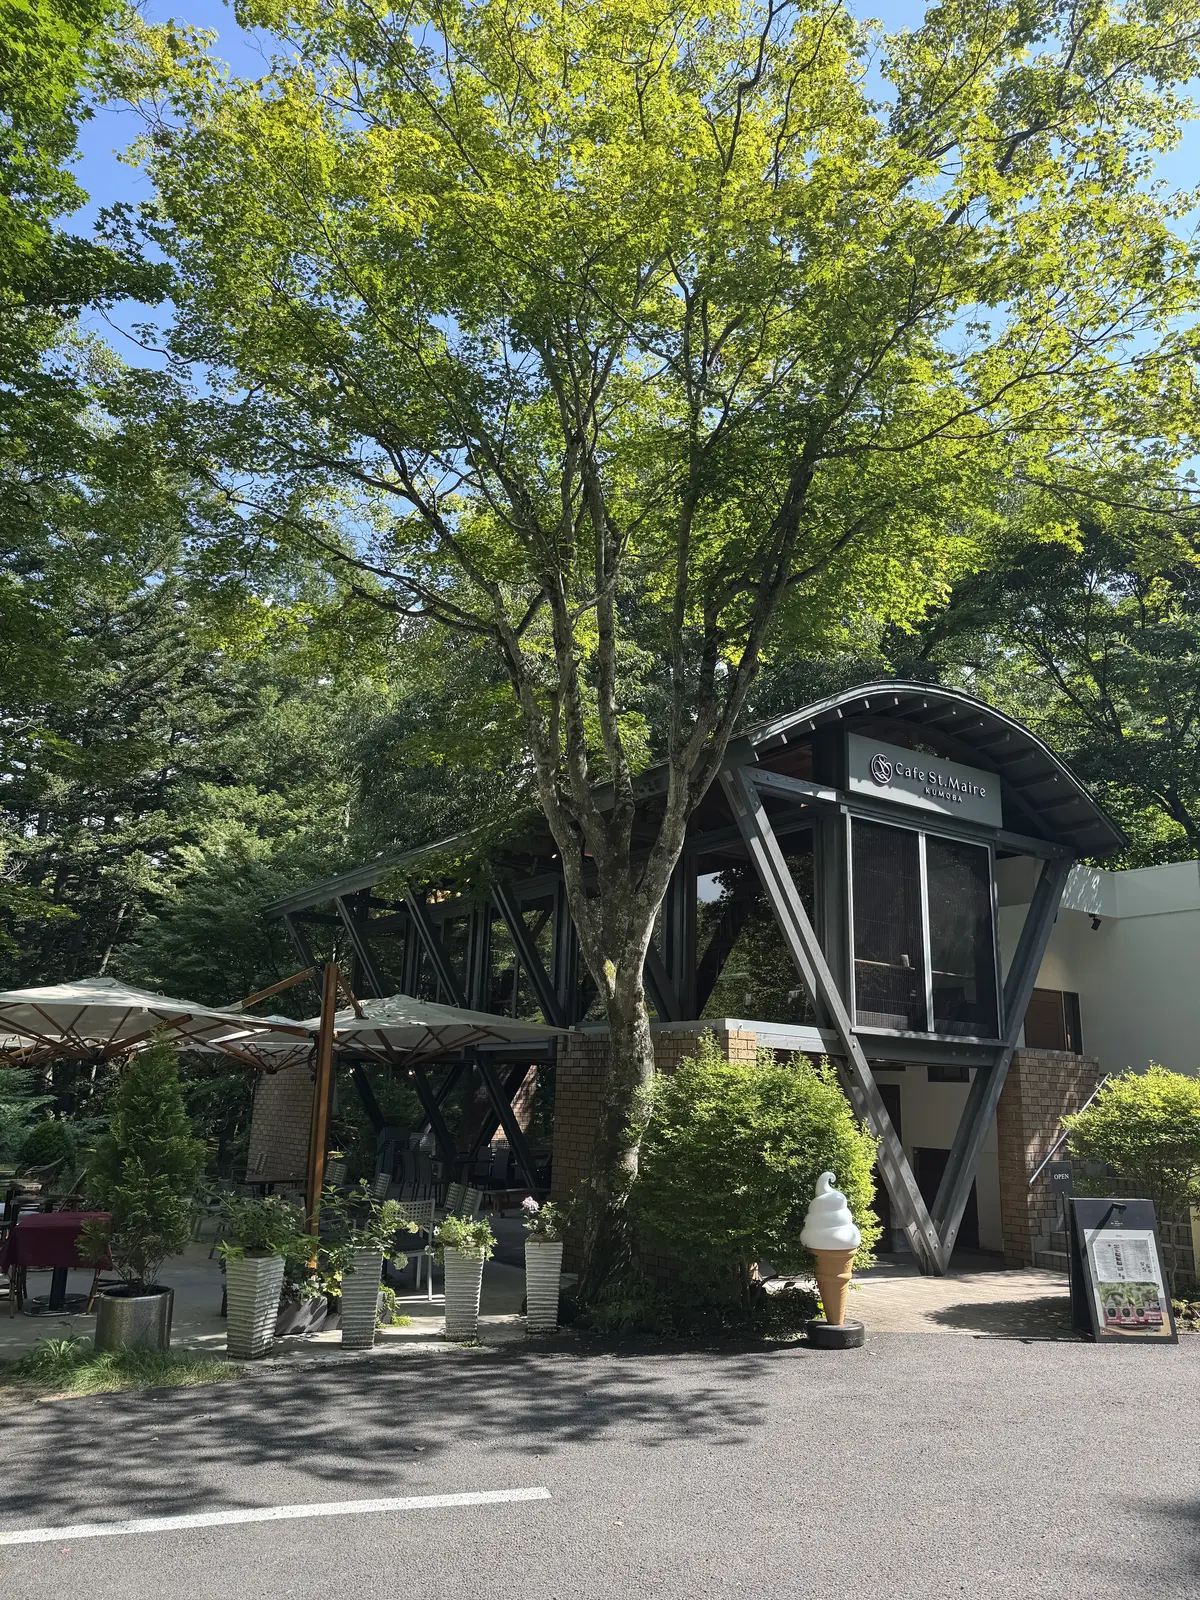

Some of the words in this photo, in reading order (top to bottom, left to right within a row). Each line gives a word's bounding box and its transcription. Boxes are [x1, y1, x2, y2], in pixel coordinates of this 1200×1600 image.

[896, 762, 925, 780] Cafe
[928, 770, 986, 797] St.Maire
[925, 787, 963, 803] KUMOBA
